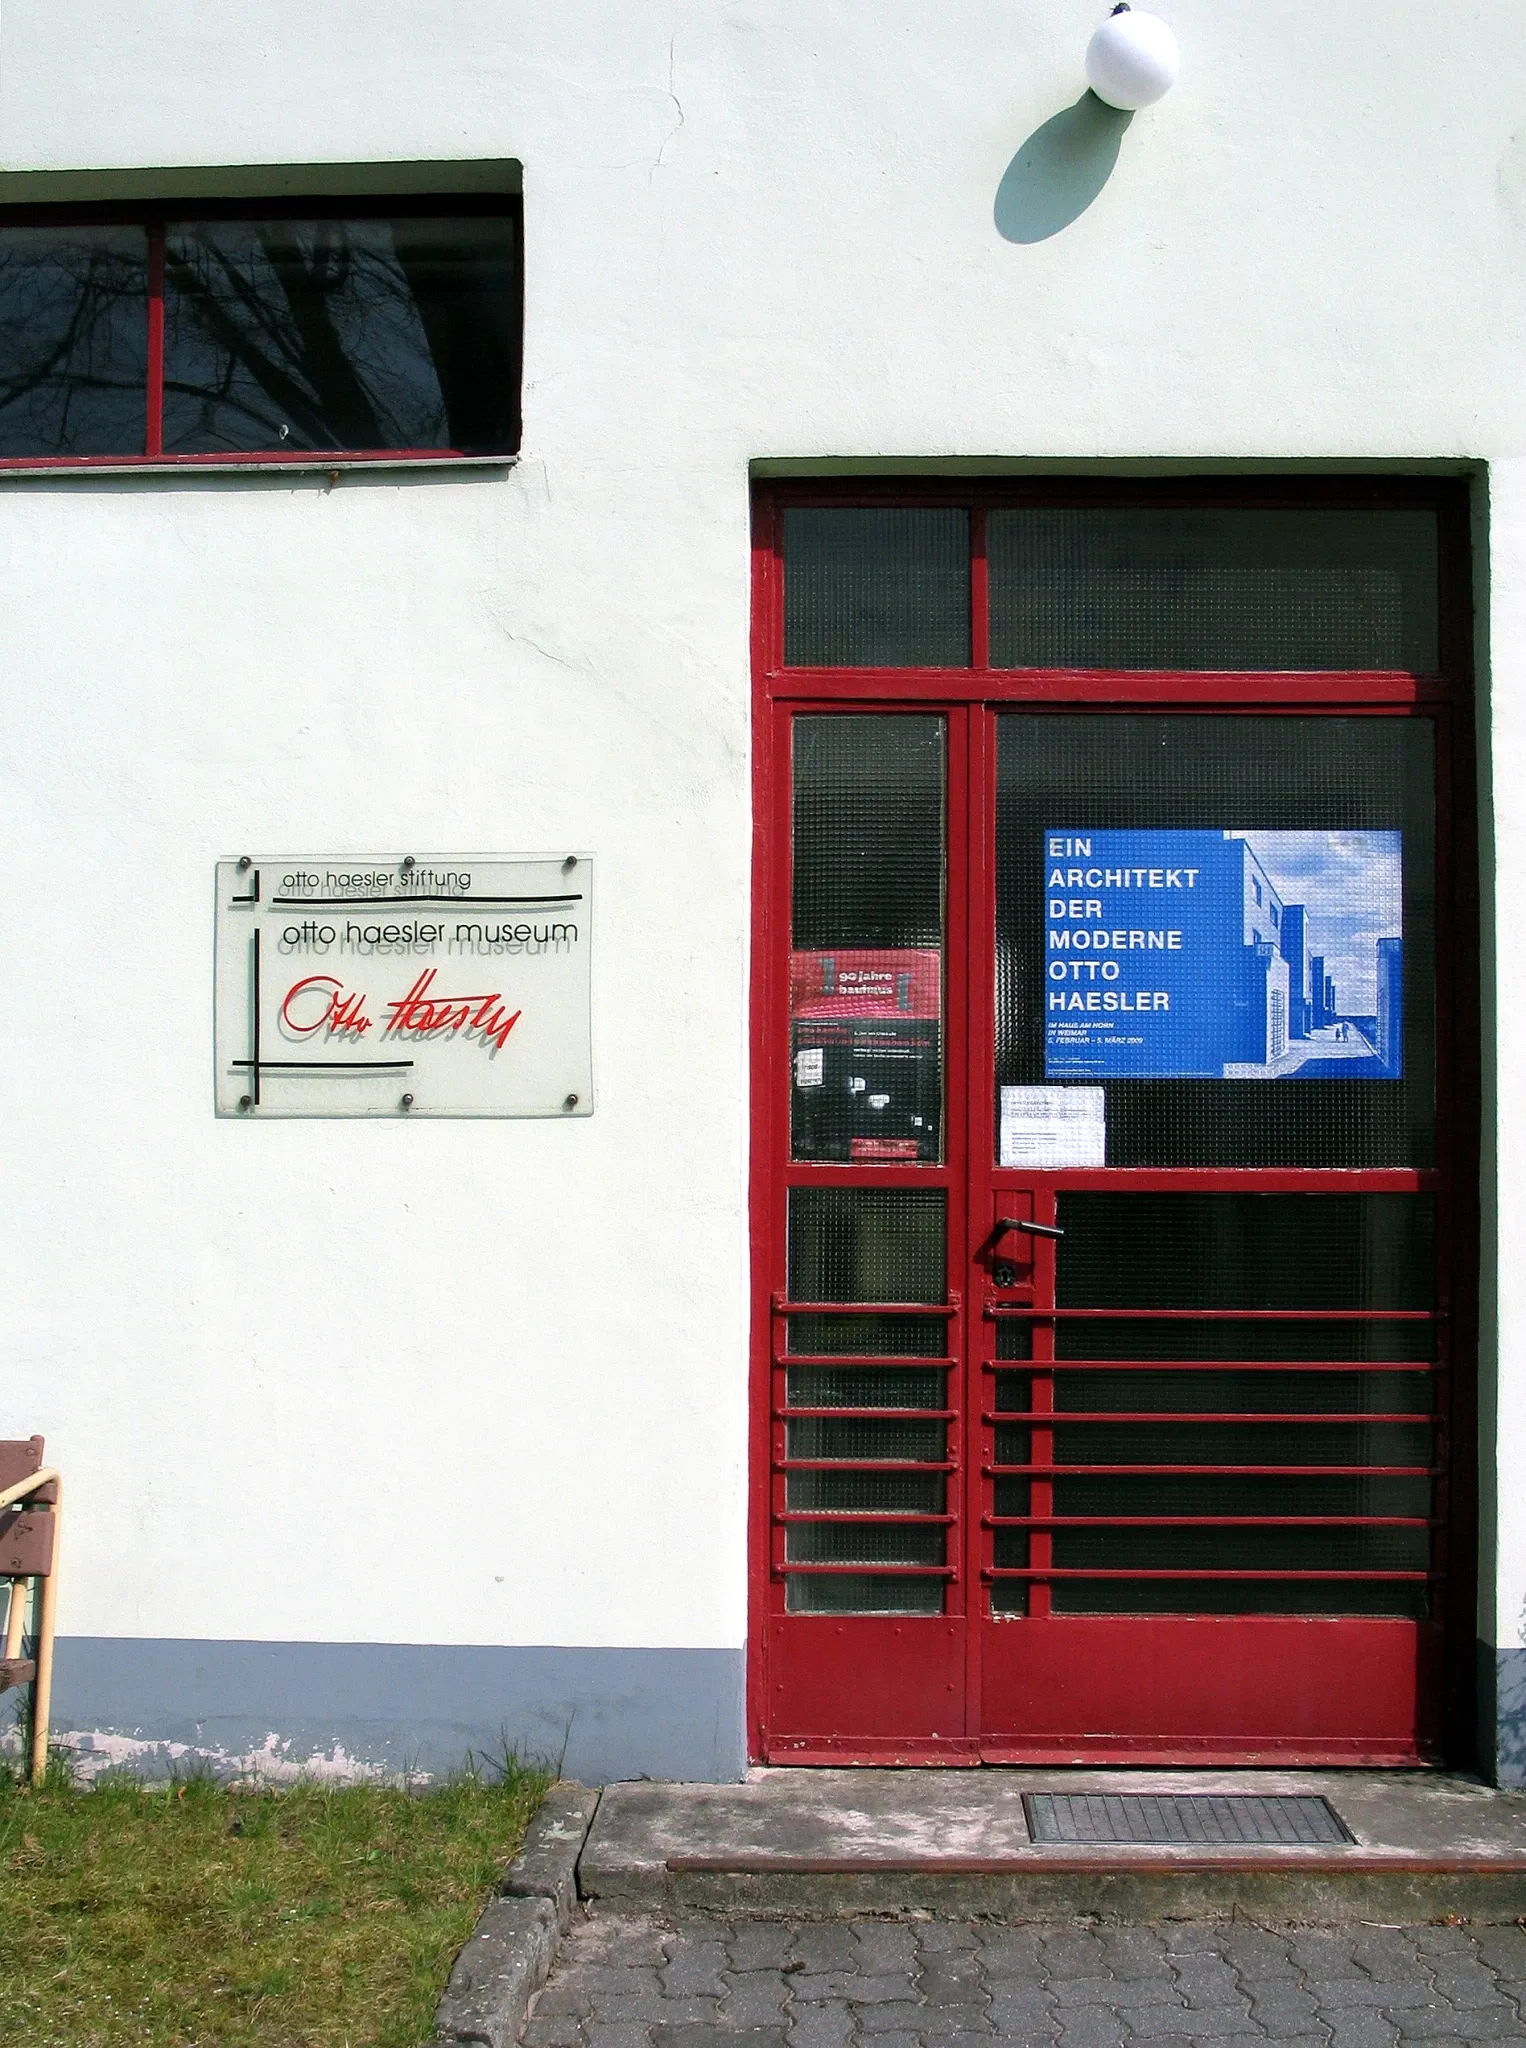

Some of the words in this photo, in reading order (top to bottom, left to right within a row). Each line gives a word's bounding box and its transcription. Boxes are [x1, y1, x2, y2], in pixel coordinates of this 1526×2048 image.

[1049, 838, 1092, 857] EIN
[283, 871, 319, 888] otto
[326, 871, 394, 887] haesler
[400, 870, 471, 889] stiftung
[1049, 869, 1199, 888] ARCHITEKT
[1050, 900, 1102, 918] DER
[283, 921, 336, 944] otto
[347, 920, 445, 943] haesler
[456, 922, 579, 942] museum
[1050, 930, 1182, 950] MODERNE
[1049, 961, 1120, 980] OTTO
[283, 975, 373, 1032] Otto
[1049, 992, 1169, 1011] HAESLER
